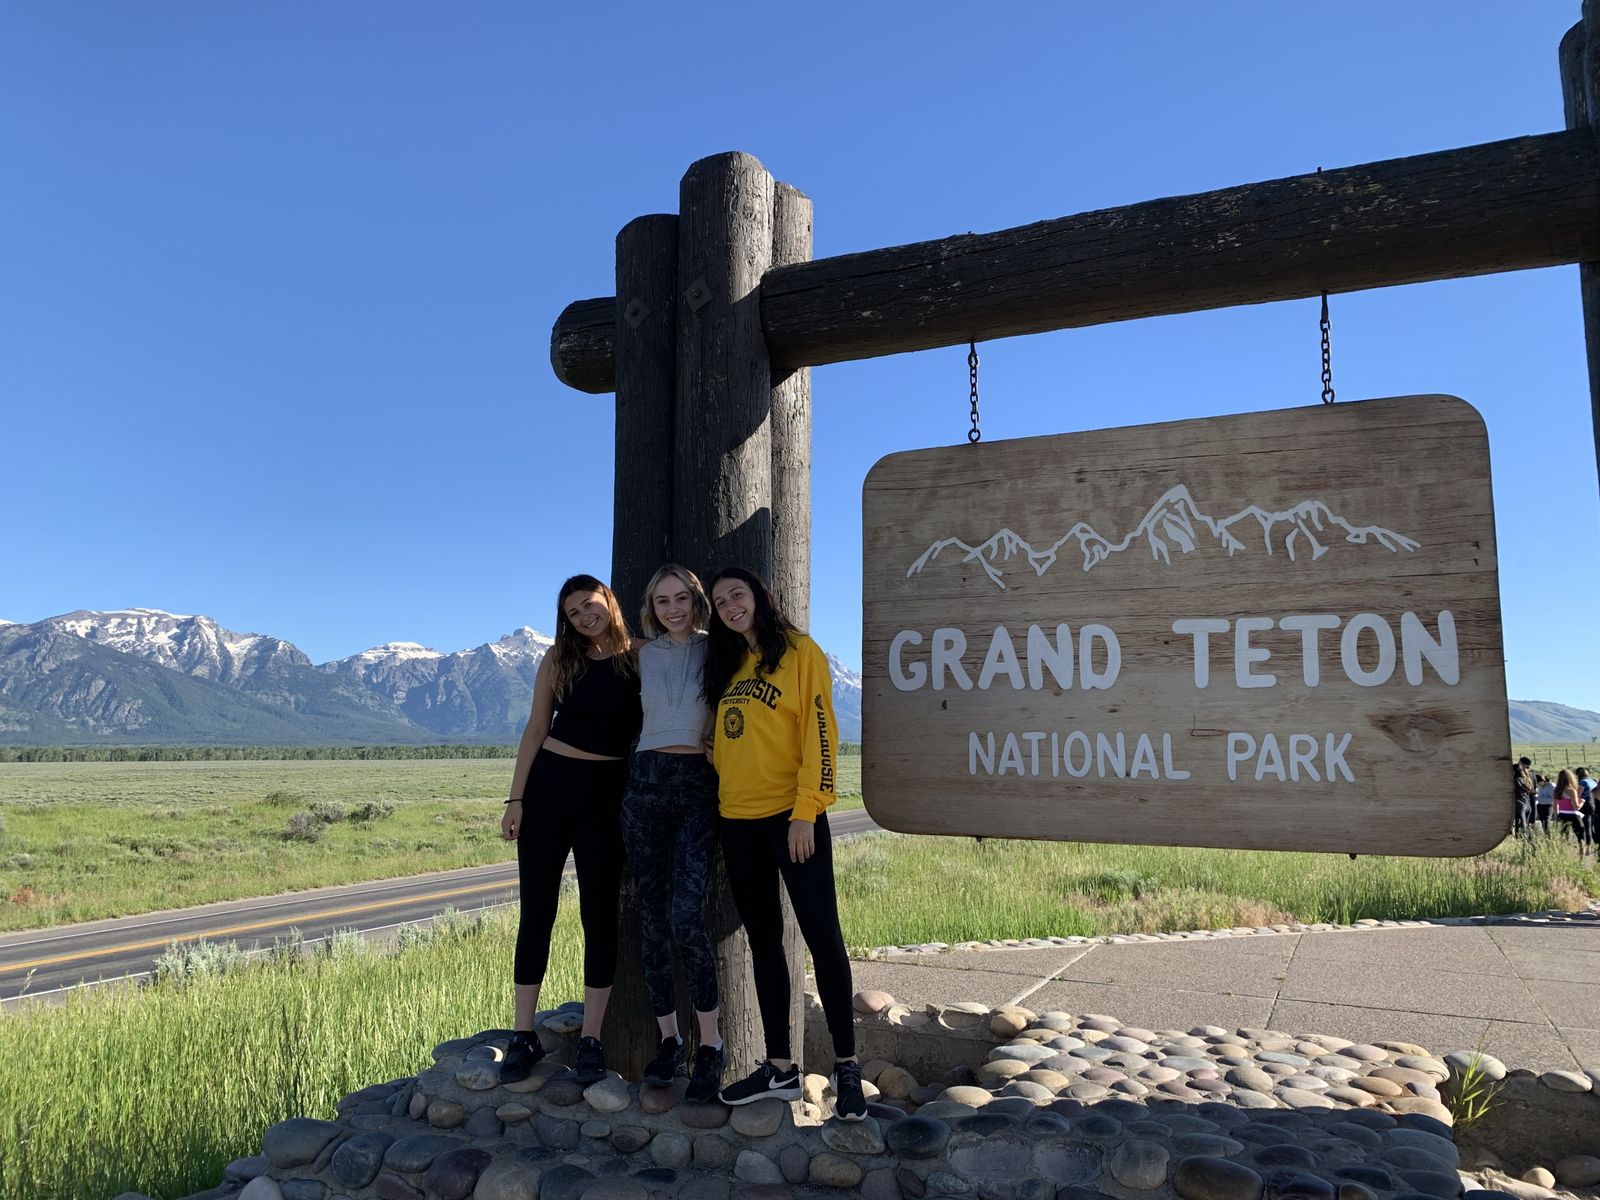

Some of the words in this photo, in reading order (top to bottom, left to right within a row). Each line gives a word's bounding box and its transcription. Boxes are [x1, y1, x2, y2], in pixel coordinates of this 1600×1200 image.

[888, 623, 1122, 692] GRAND
[1171, 609, 1461, 689] TETON
[721, 679, 782, 710] LHOOSIE
[968, 730, 1191, 780] NATIONAL
[1226, 731, 1356, 783] PARK
